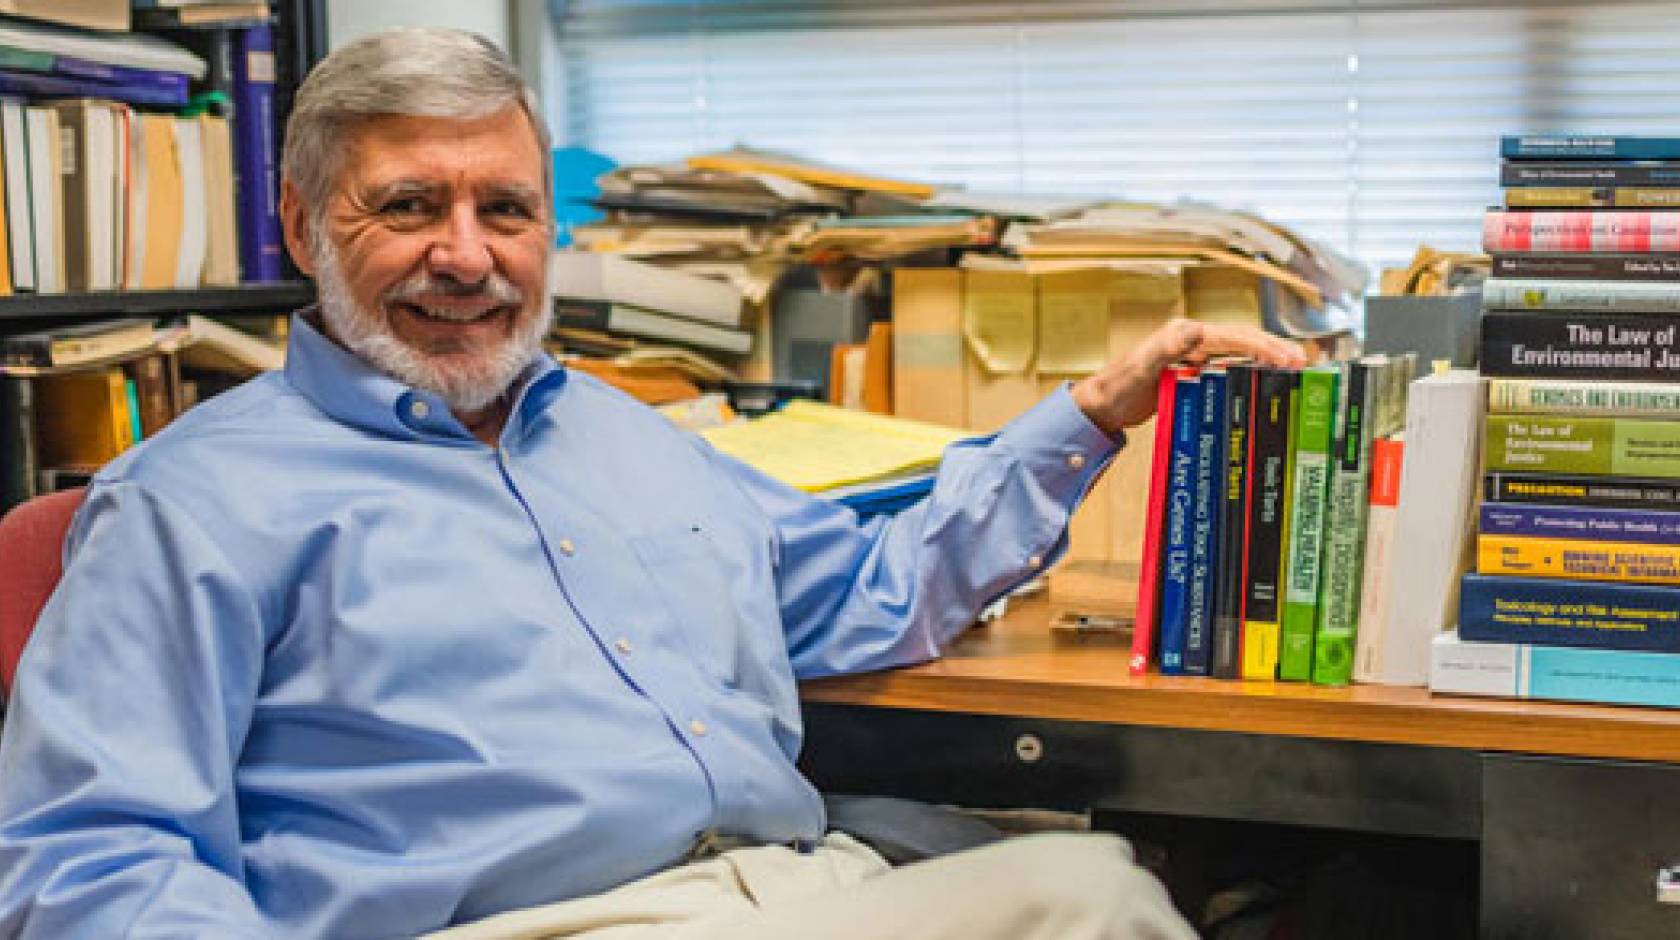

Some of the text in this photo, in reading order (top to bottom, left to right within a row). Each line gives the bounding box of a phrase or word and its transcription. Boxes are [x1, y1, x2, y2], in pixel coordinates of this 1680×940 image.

[1567, 324, 1674, 345] The Law of
[1511, 343, 1650, 368] Environmental
[1168, 451, 1192, 584] Are Genes Us?
[1495, 598, 1558, 616] Toxicology
[1560, 602, 1584, 616] and
